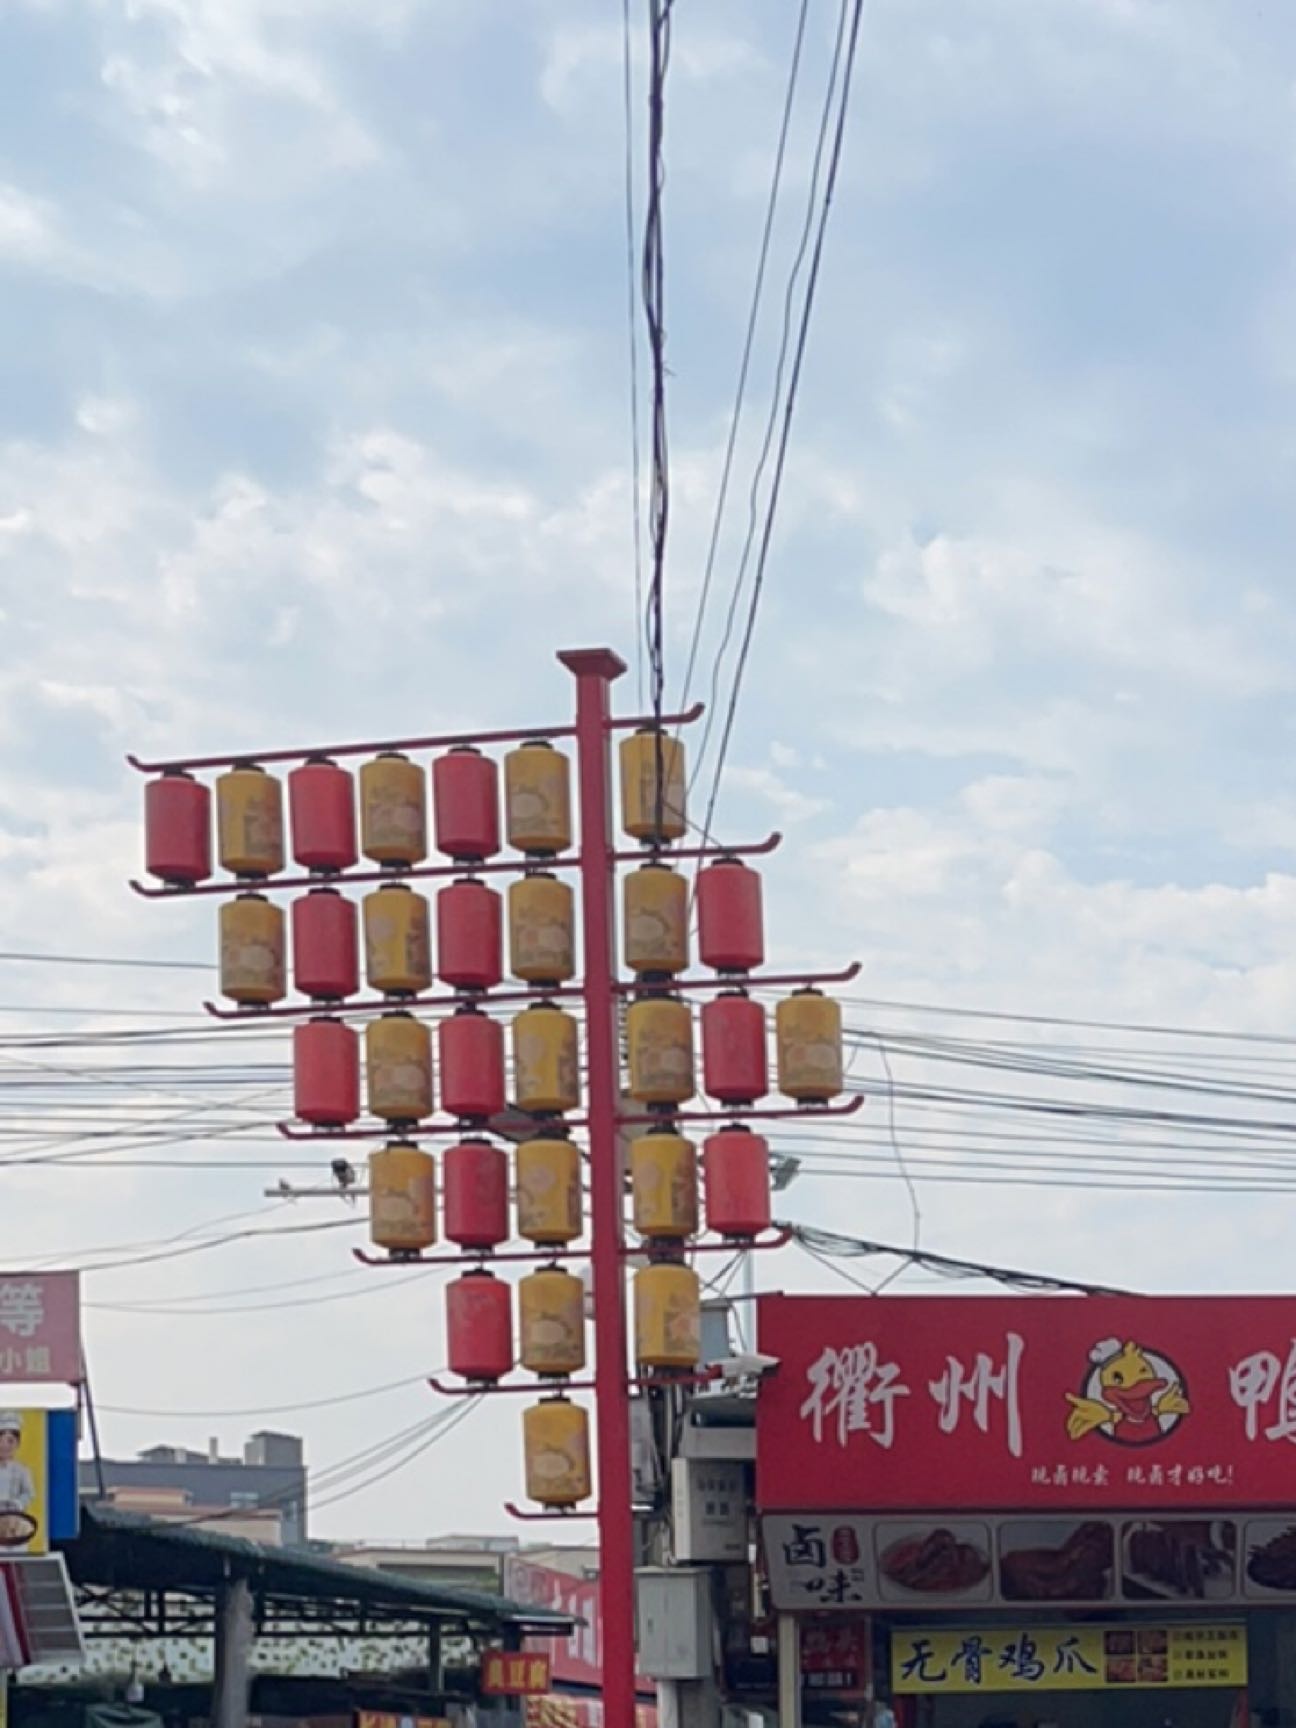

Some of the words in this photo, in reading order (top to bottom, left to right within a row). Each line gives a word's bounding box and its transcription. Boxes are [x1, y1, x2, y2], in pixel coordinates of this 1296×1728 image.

[800, 1333, 1026, 1457] 衢州
[900, 1636, 1099, 1686] 无骨鸡爪
